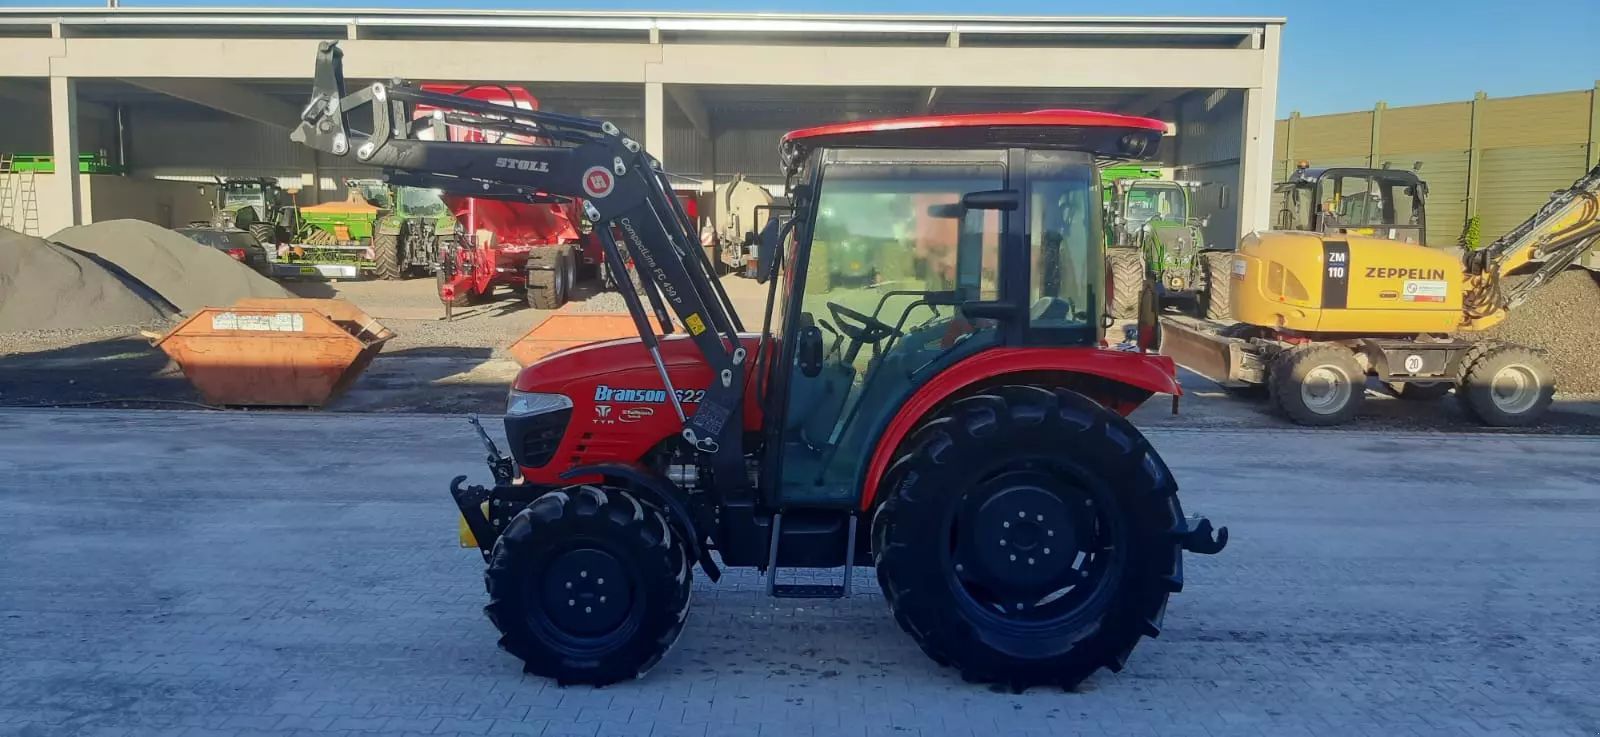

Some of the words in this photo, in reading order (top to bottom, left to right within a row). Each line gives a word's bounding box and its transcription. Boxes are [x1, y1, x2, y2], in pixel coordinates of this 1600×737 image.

[496, 157, 549, 173] STOLL
[621, 217, 656, 268] CompactLine
[653, 267, 666, 281] FC
[663, 281, 677, 297] 450
[673, 296, 682, 304] P
[1329, 252, 1345, 263] ZM
[1327, 266, 1344, 278] 110
[1365, 267, 1445, 280] ZEPPELIN
[1408, 358, 1420, 370] 20
[594, 385, 666, 403] Branson
